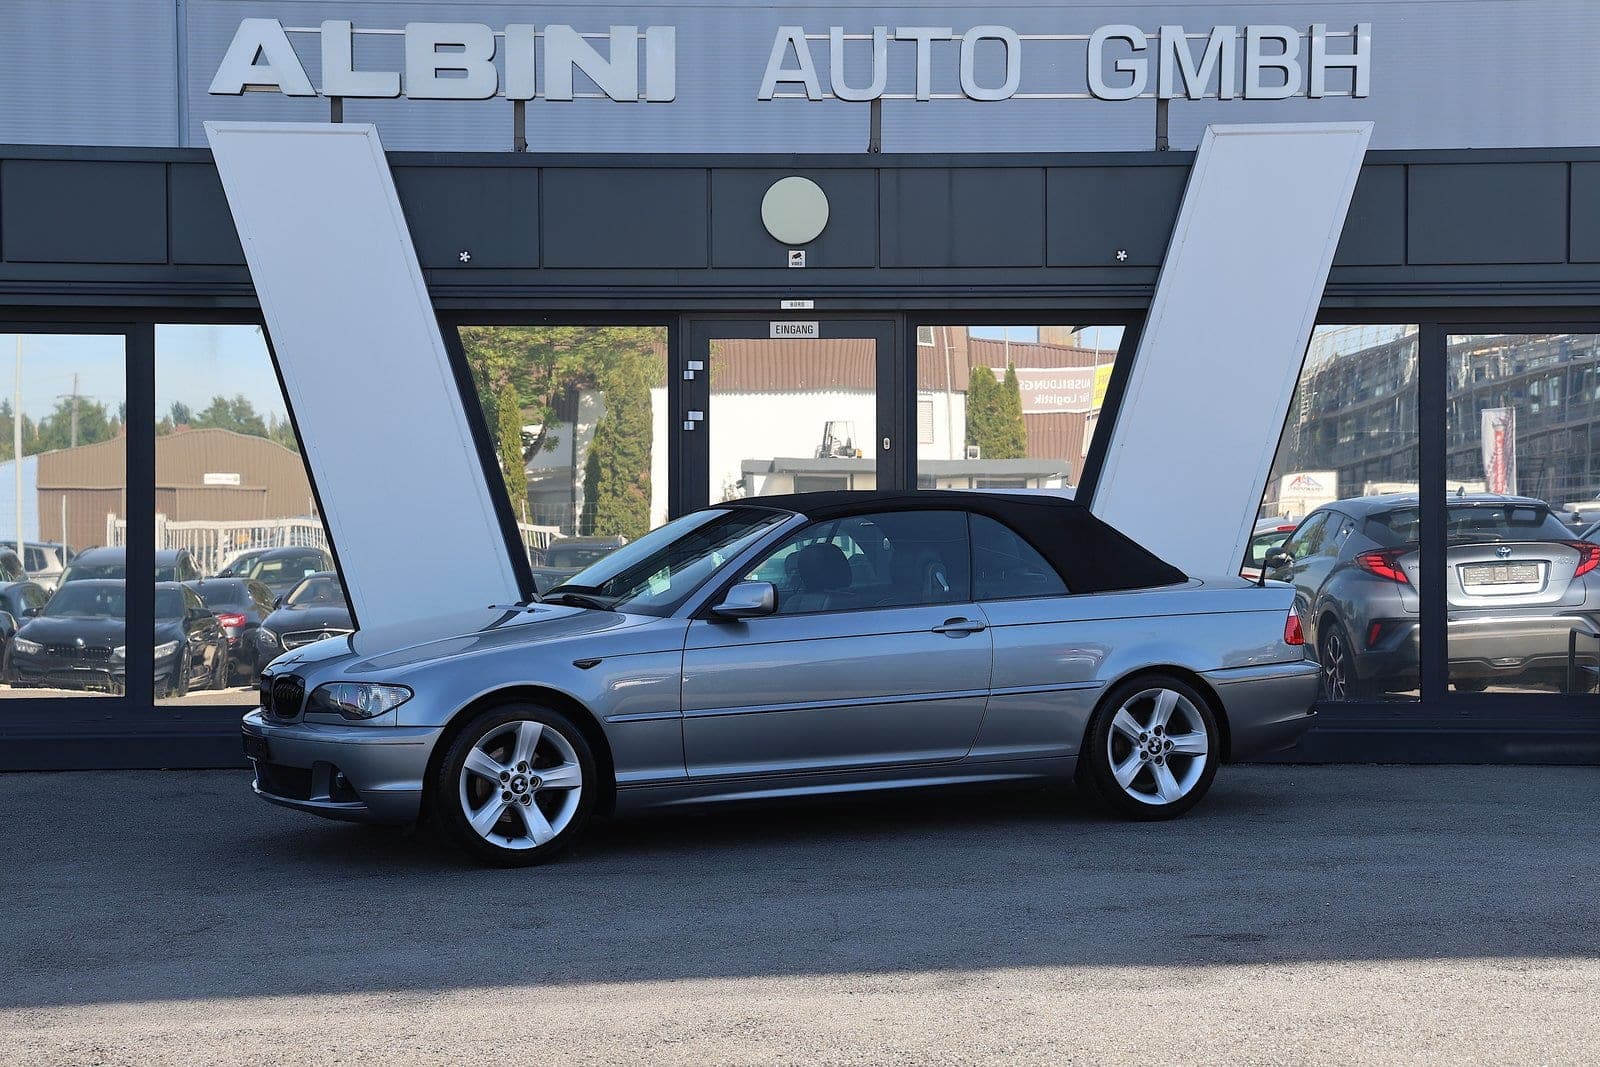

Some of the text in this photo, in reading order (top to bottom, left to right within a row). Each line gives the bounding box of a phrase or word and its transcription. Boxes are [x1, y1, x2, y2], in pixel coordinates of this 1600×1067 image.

[209, 17, 1372, 102] ALBINI AUTO GMBH
[775, 324, 814, 335] EINGANG
